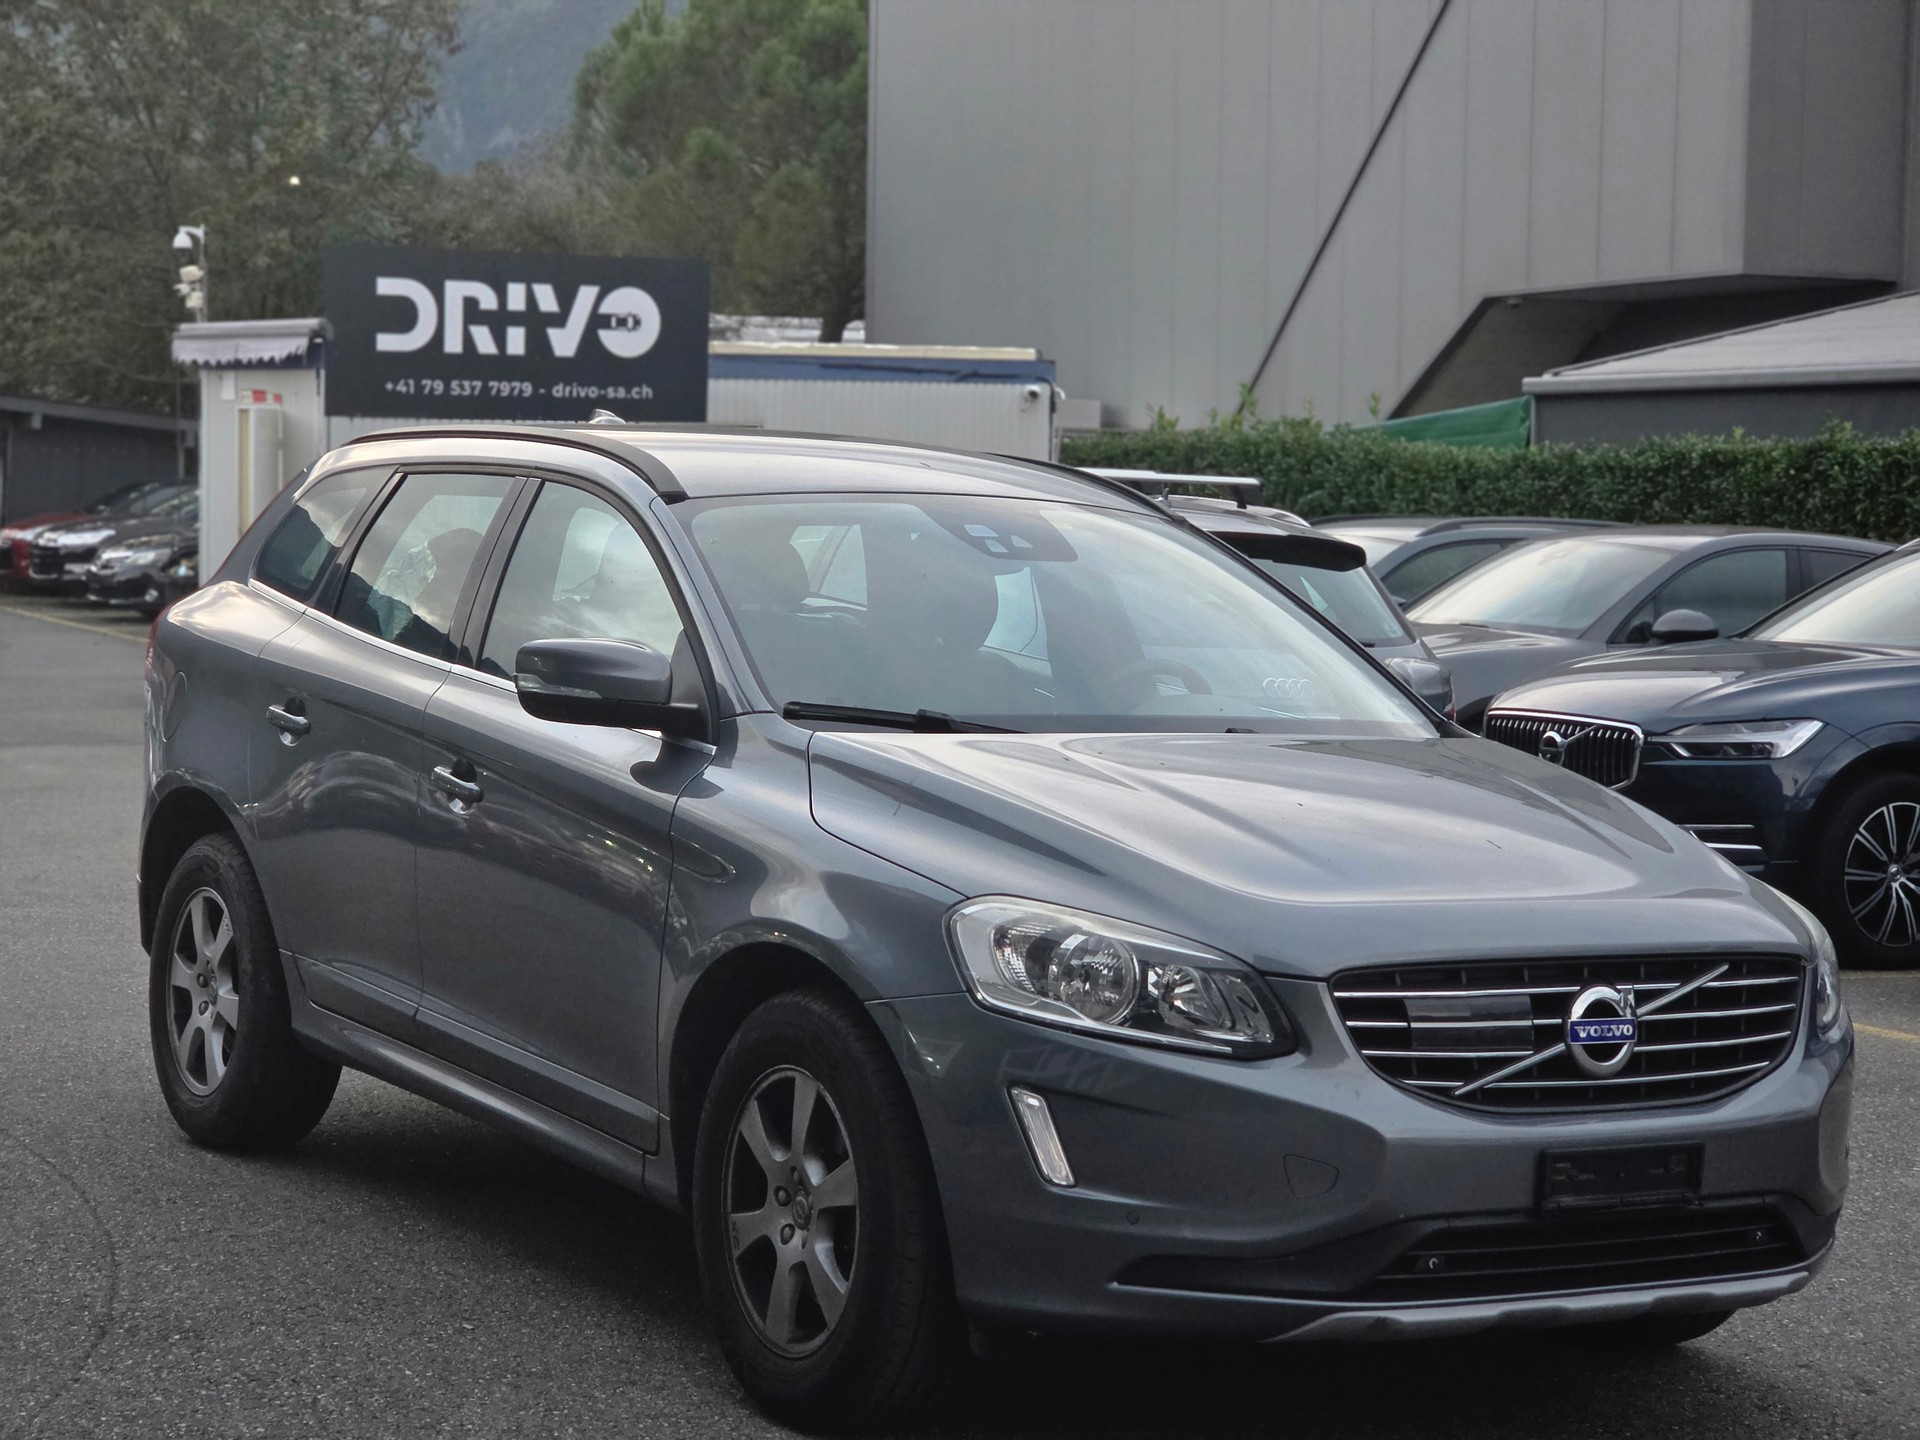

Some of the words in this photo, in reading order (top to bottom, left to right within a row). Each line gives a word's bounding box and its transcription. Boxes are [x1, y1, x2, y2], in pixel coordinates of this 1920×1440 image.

[376, 276, 661, 359] DRIVO
[385, 379, 415, 394] +41
[421, 379, 444, 395] 79
[450, 380, 482, 396] 537
[488, 381, 533, 397] 7979
[552, 382, 653, 400] drivo-sa.ch
[1574, 1024, 1634, 1038] VOLVO
